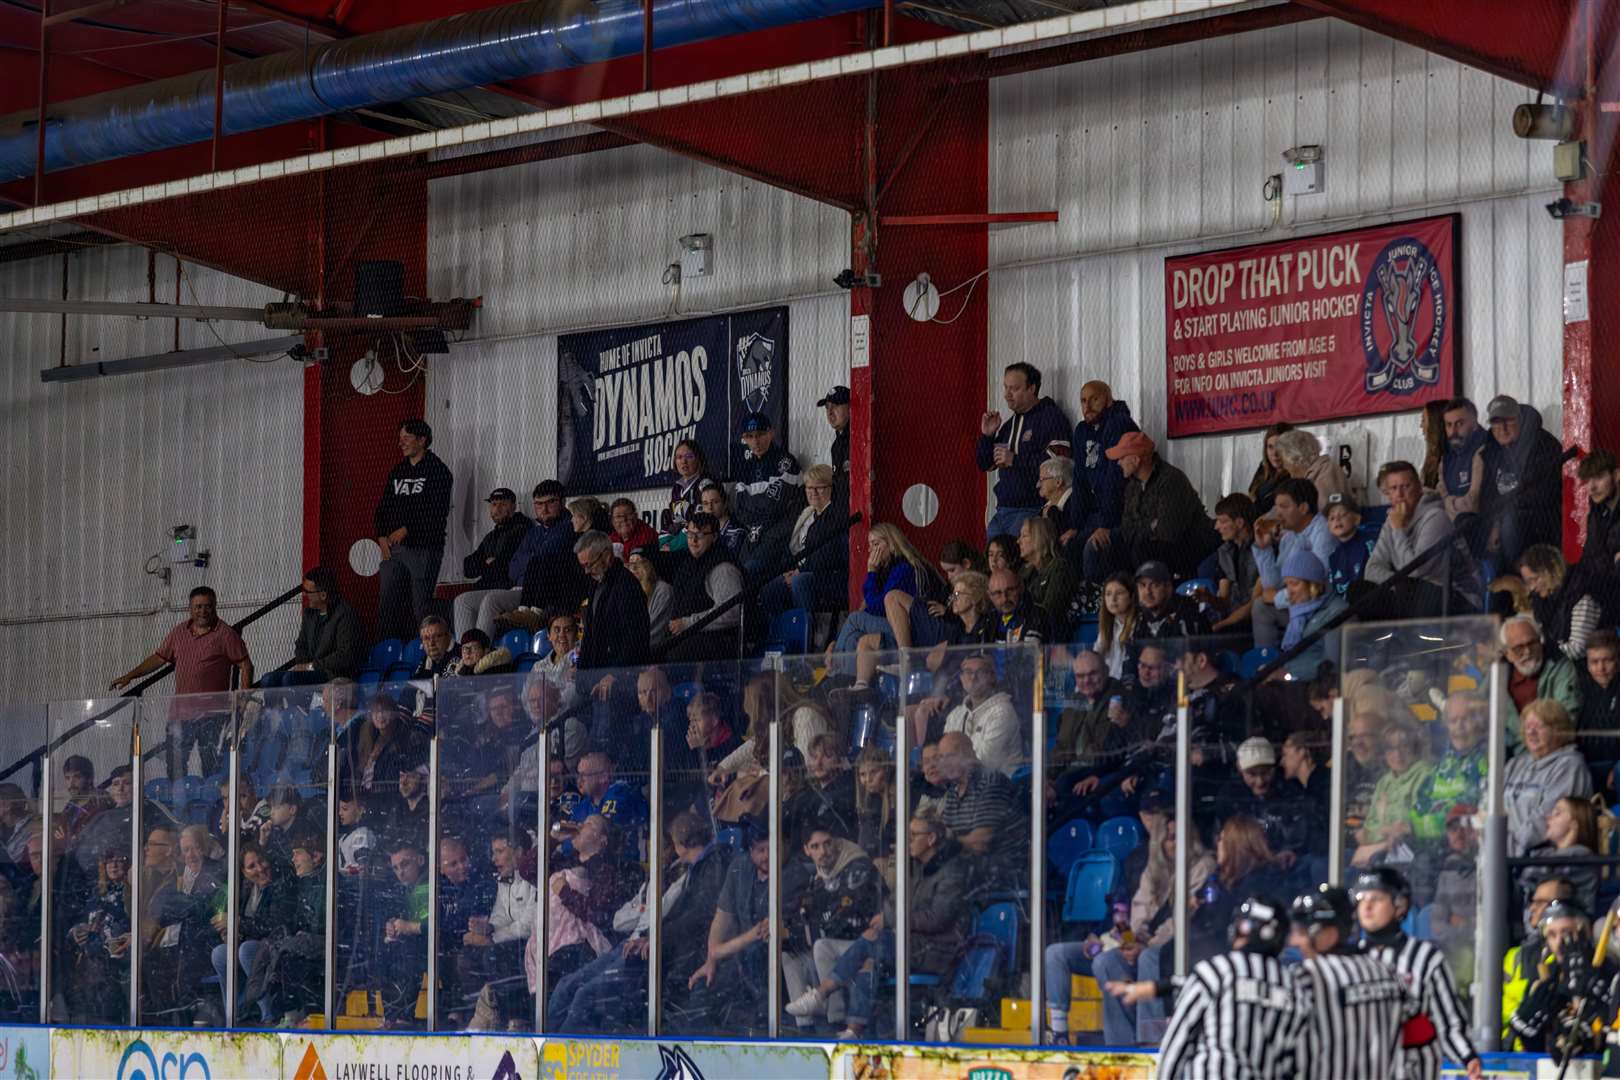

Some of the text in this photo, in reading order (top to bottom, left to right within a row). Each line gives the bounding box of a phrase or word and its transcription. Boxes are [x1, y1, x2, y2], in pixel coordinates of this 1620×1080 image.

[1387, 245, 1418, 262] JUNIOR
[1173, 243, 1361, 309] DROP THAT PUCK
[1173, 294, 1360, 340] & START PLAYING JUNIOR HOCKEY
[1364, 291, 1374, 352] INVICTA
[600, 334, 662, 373] HOME OF INVICTA
[1173, 335, 1336, 372] BOYS & GIRLS WELCOME FROM AGE 5
[1174, 359, 1328, 396] FOR INFO ON INVICTA JUNIORS VISIT
[1392, 376, 1415, 390] CLUB
[592, 345, 708, 451] DYNAMOS
[336, 1063, 475, 1080] LAYWELL FLOORING &
[568, 1042, 620, 1067] SPYDER
